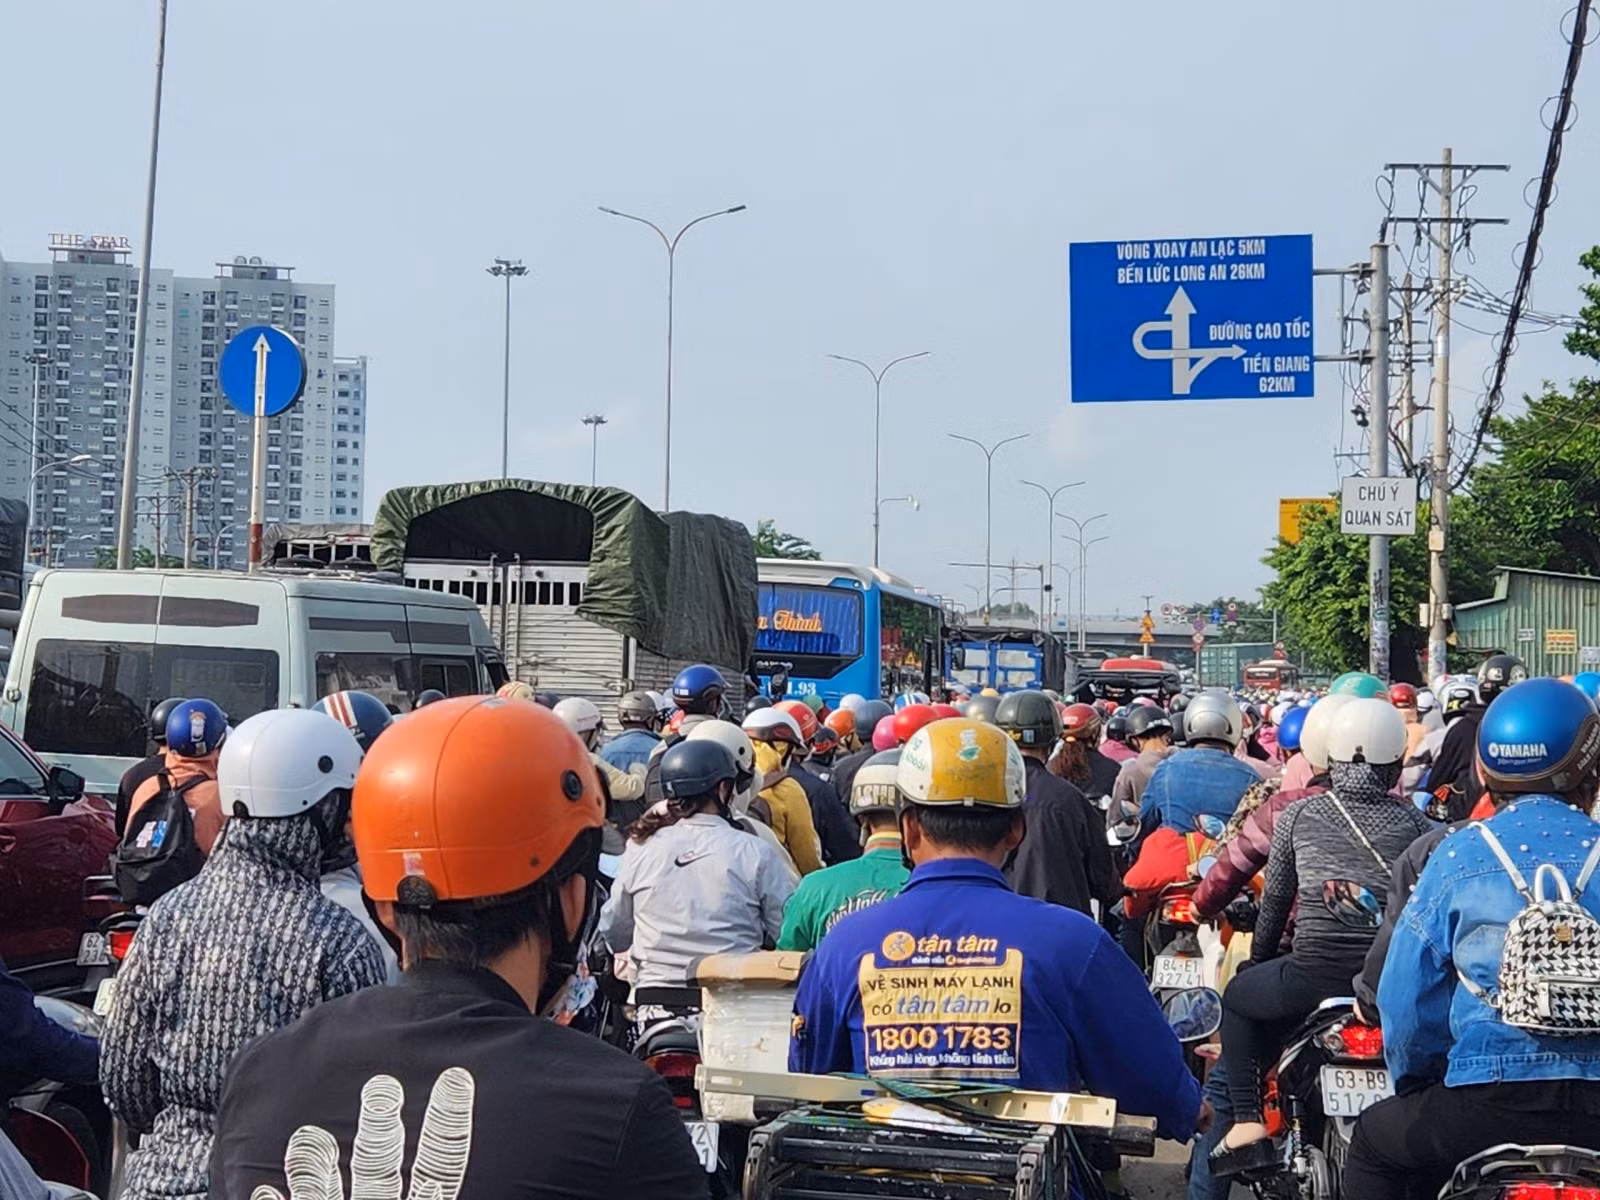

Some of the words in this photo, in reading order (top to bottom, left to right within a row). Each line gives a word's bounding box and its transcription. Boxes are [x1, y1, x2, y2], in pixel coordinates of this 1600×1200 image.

[1153, 241, 1187, 259] XOAY
[1190, 241, 1207, 258] AN
[1210, 239, 1234, 259] LẠC
[1238, 238, 1266, 256] 5KM
[1146, 262, 1170, 283] LỨC
[1174, 265, 1206, 283] LONG
[1209, 264, 1227, 281] AN
[1230, 262, 1266, 280] 26KM
[1255, 322, 1282, 340] CAO
[1285, 315, 1311, 339] TỐC
[1274, 355, 1310, 372] GIANG
[1259, 376, 1295, 393] 62KM
[1358, 482, 1386, 501] CHÚ
[1390, 481, 1400, 501] Ý
[1345, 510, 1382, 526] QUAN
[1386, 507, 1412, 526] SÁT
[1499, 743, 1547, 758] YAMAHA
[957, 934, 998, 953] tâm
[866, 974, 886, 991] VỆ
[891, 977, 928, 989] SINH
[933, 971, 967, 988] MÁY
[972, 976, 1014, 991] LẠNH
[872, 999, 893, 1016] có
[943, 994, 989, 1015] tâm
[871, 1027, 938, 1052] 1800
[943, 1026, 1012, 1050] 1783
[1335, 1070, 1387, 1090] 63-B9
